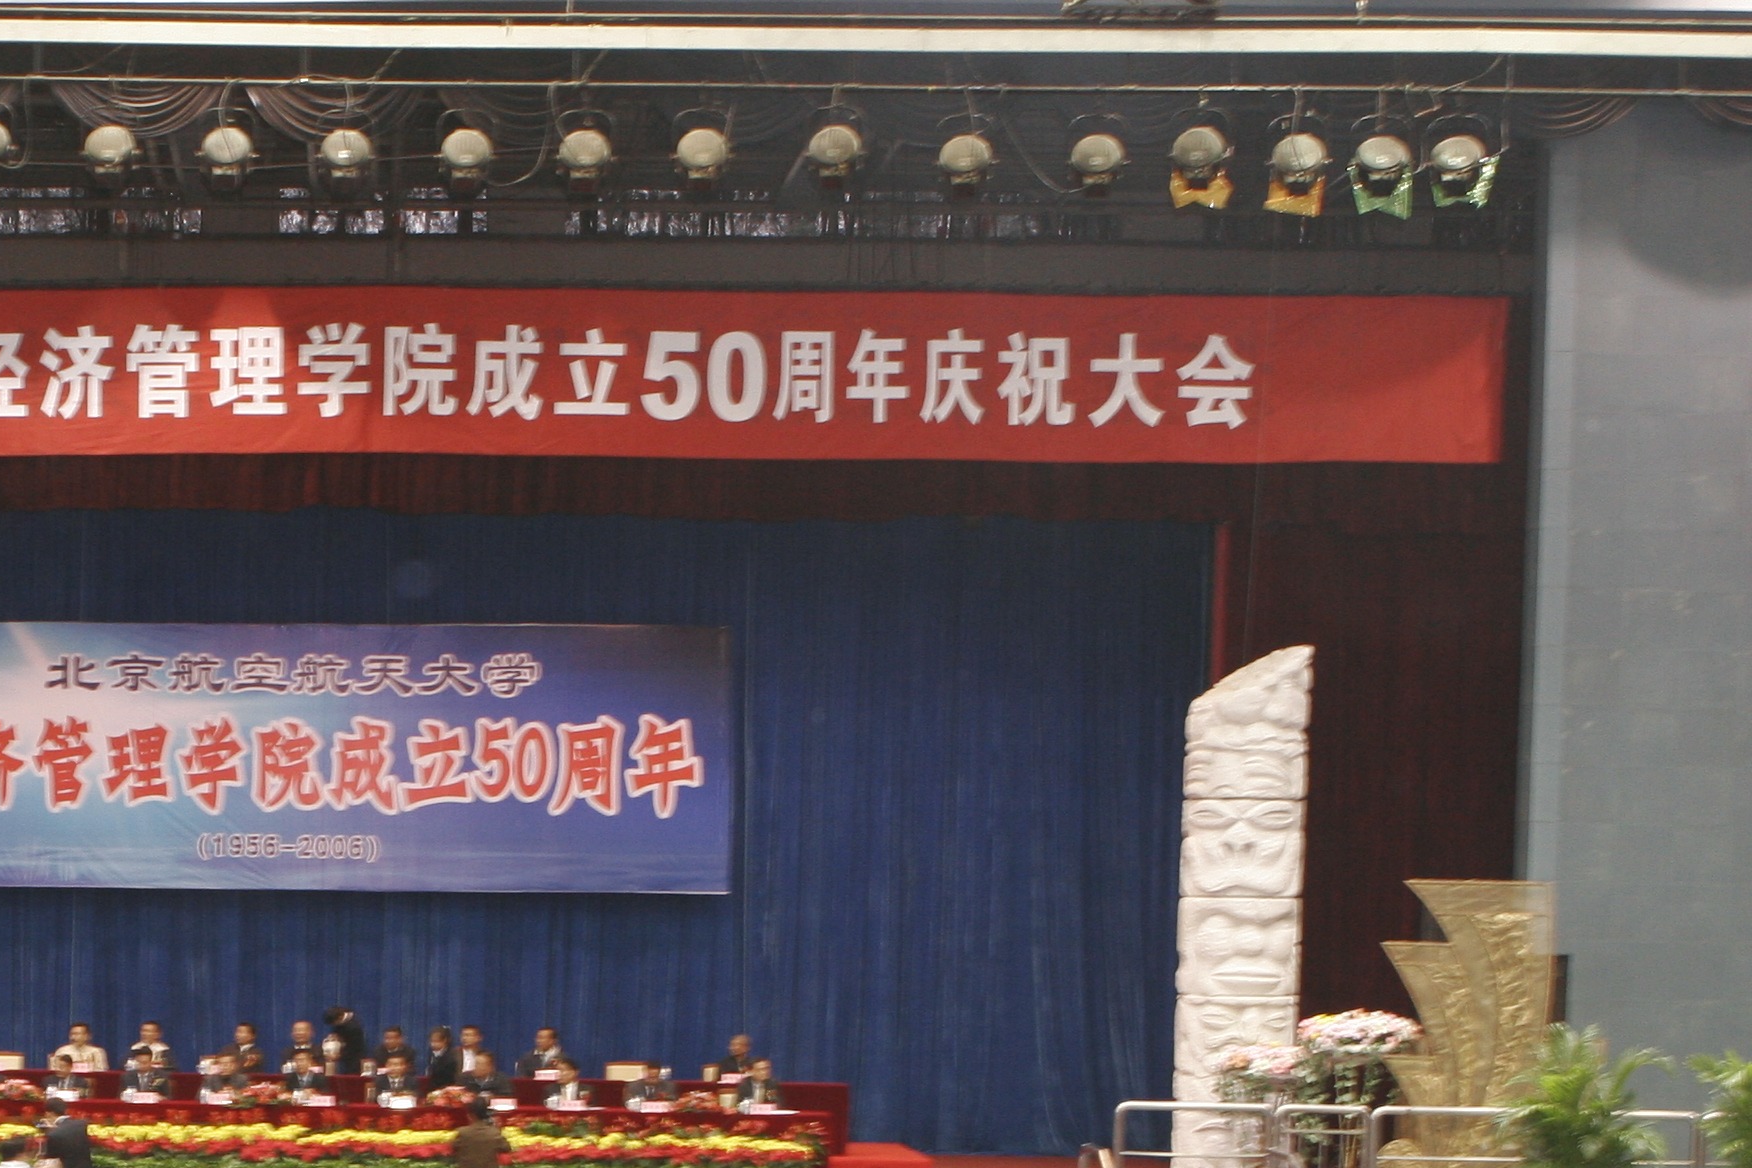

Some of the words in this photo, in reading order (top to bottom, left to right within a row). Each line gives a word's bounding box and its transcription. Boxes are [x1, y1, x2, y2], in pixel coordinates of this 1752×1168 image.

[44, 652, 542, 698] 北京航空航天大学
